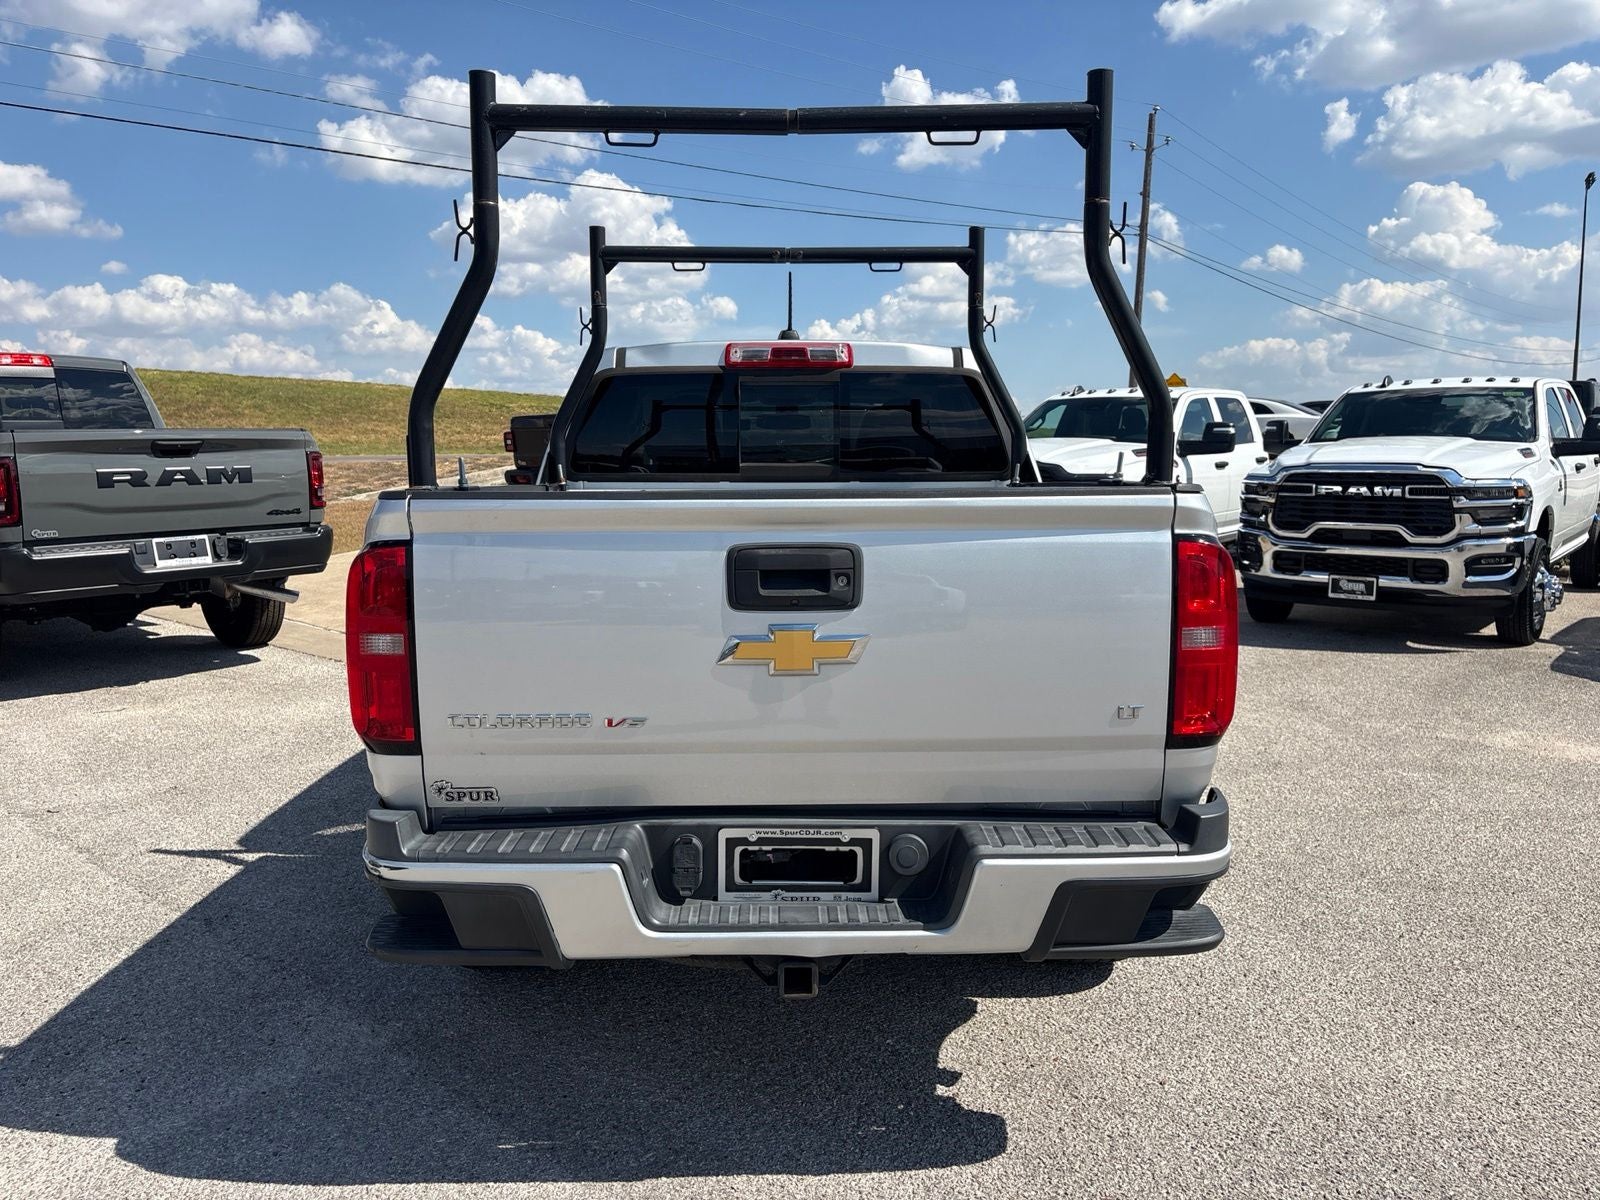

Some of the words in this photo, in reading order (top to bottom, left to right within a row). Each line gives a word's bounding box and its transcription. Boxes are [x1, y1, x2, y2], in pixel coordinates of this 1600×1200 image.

[96, 466, 252, 488] RAM
[1316, 485, 1402, 497] RAM
[1117, 704, 1144, 719] LT
[447, 713, 592, 729] COLORADO
[603, 717, 648, 728] V6
[445, 790, 496, 801] SPUR
[755, 829, 843, 837] www.SpurCDJR.com
